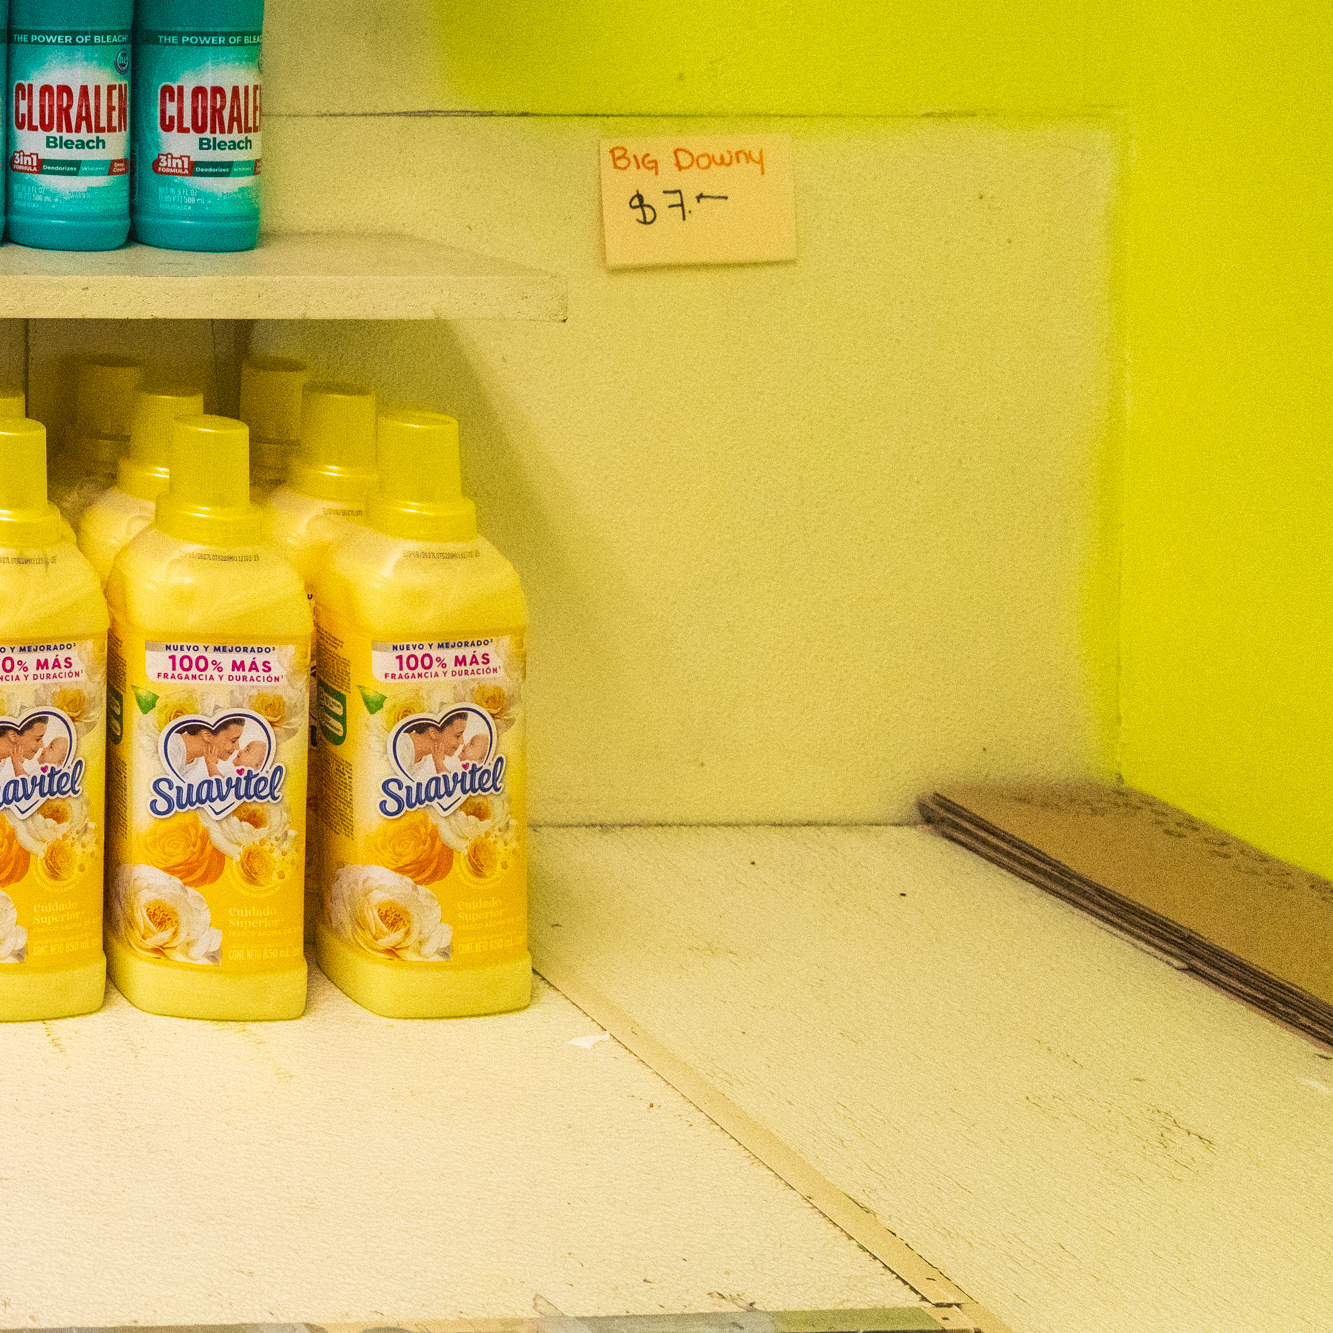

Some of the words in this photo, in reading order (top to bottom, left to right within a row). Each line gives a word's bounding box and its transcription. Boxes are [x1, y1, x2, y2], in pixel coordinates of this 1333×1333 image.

[13, 34, 28, 42] THE
[31, 35, 72, 43] POWER
[76, 35, 91, 43] OF
[94, 34, 127, 43] BLEACH
[14, 83, 128, 134] CLORALEN
[45, 135, 106, 150] Bleach
[610, 146, 659, 176] BIG
[673, 147, 765, 176] Downy
[36, 654, 73, 671] MÁS
[150, 766, 284, 818] Suavitel
[379, 767, 503, 819] Suavitel
